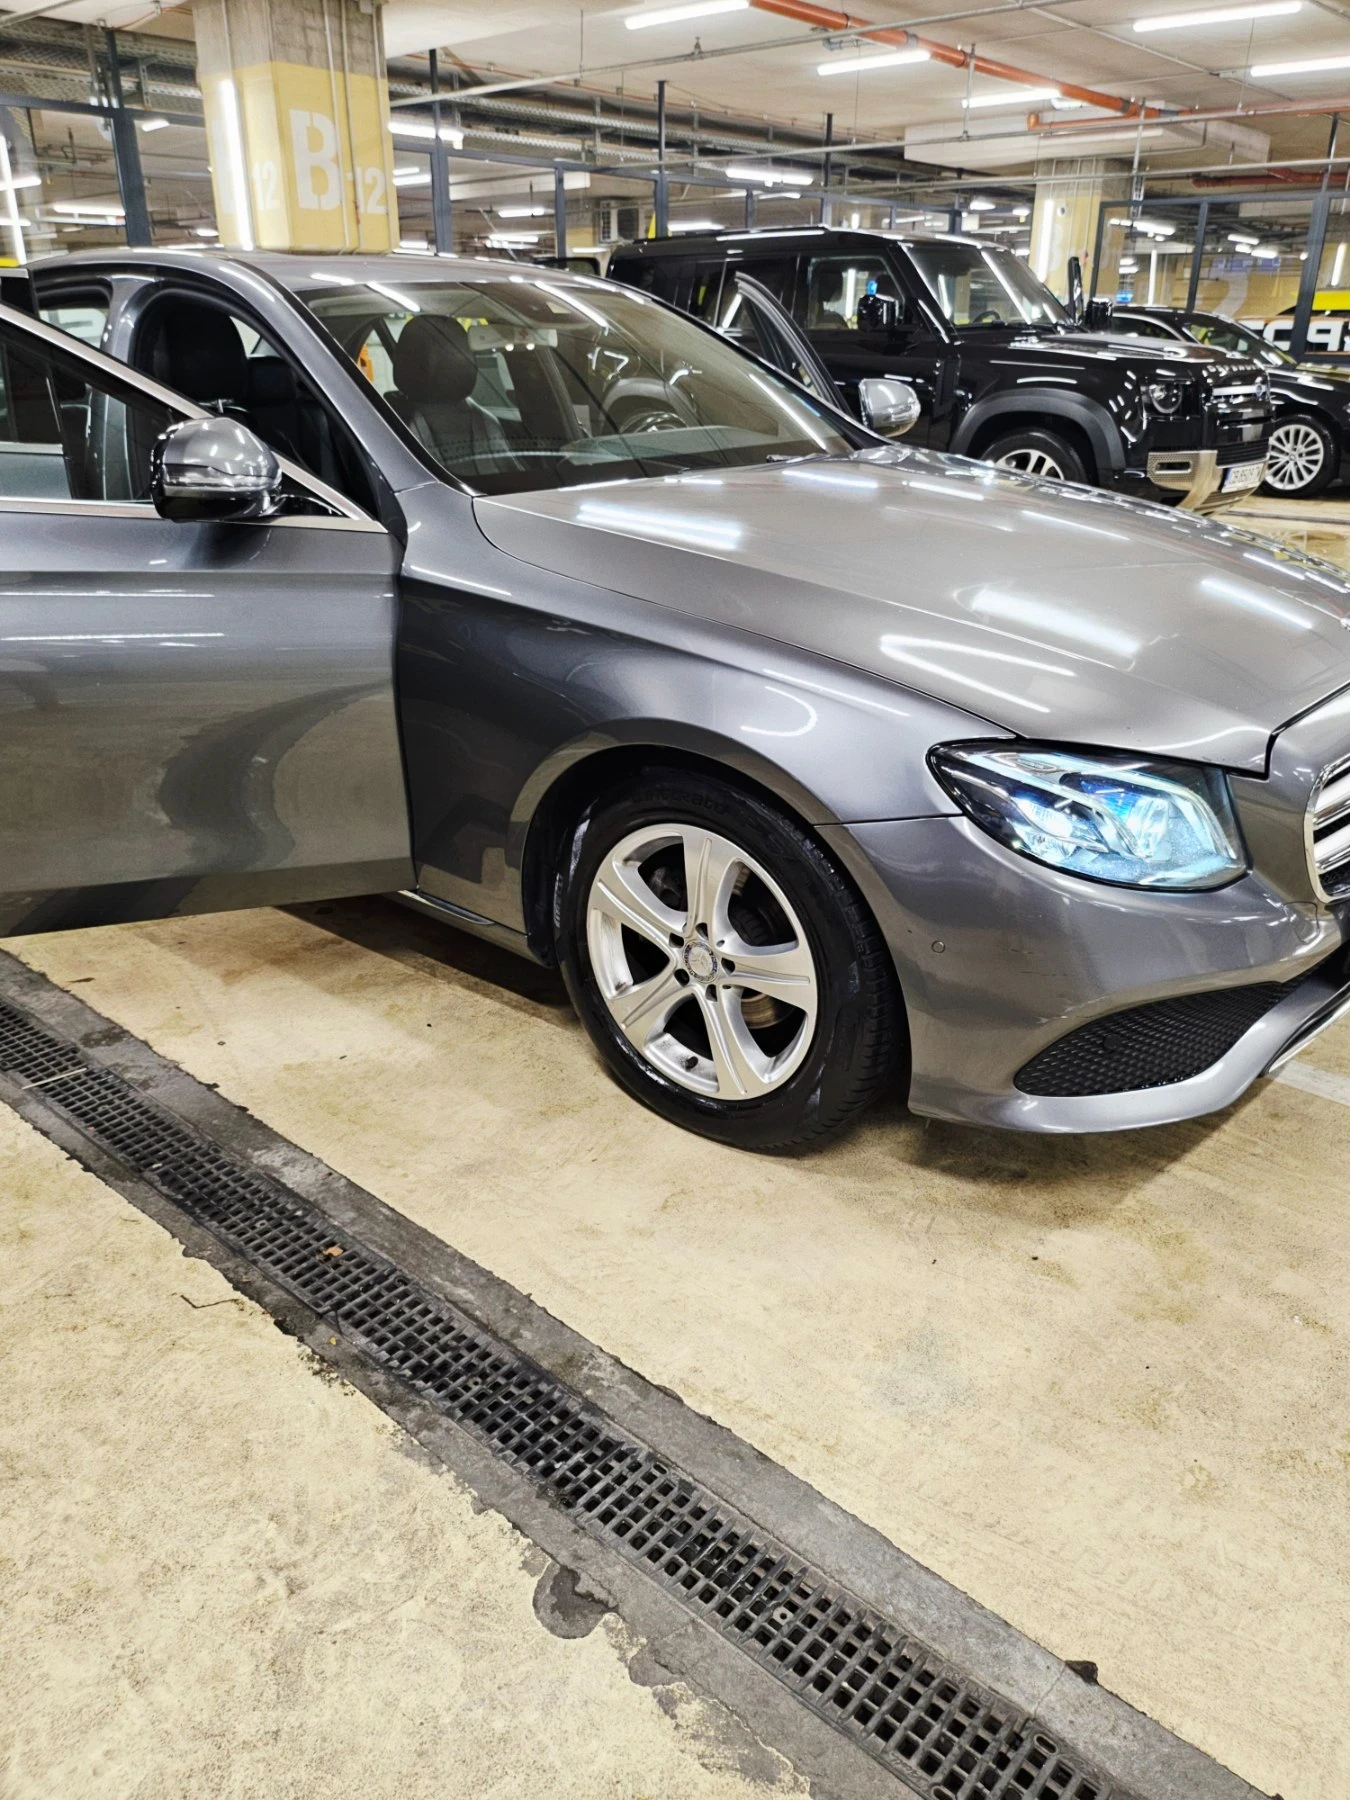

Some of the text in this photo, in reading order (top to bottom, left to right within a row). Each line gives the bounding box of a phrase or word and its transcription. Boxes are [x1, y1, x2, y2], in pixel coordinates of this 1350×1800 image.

[252, 160, 281, 211] 12
[289, 109, 341, 210] B
[346, 165, 387, 215] 12
[971, 1687, 992, 1704] EN
